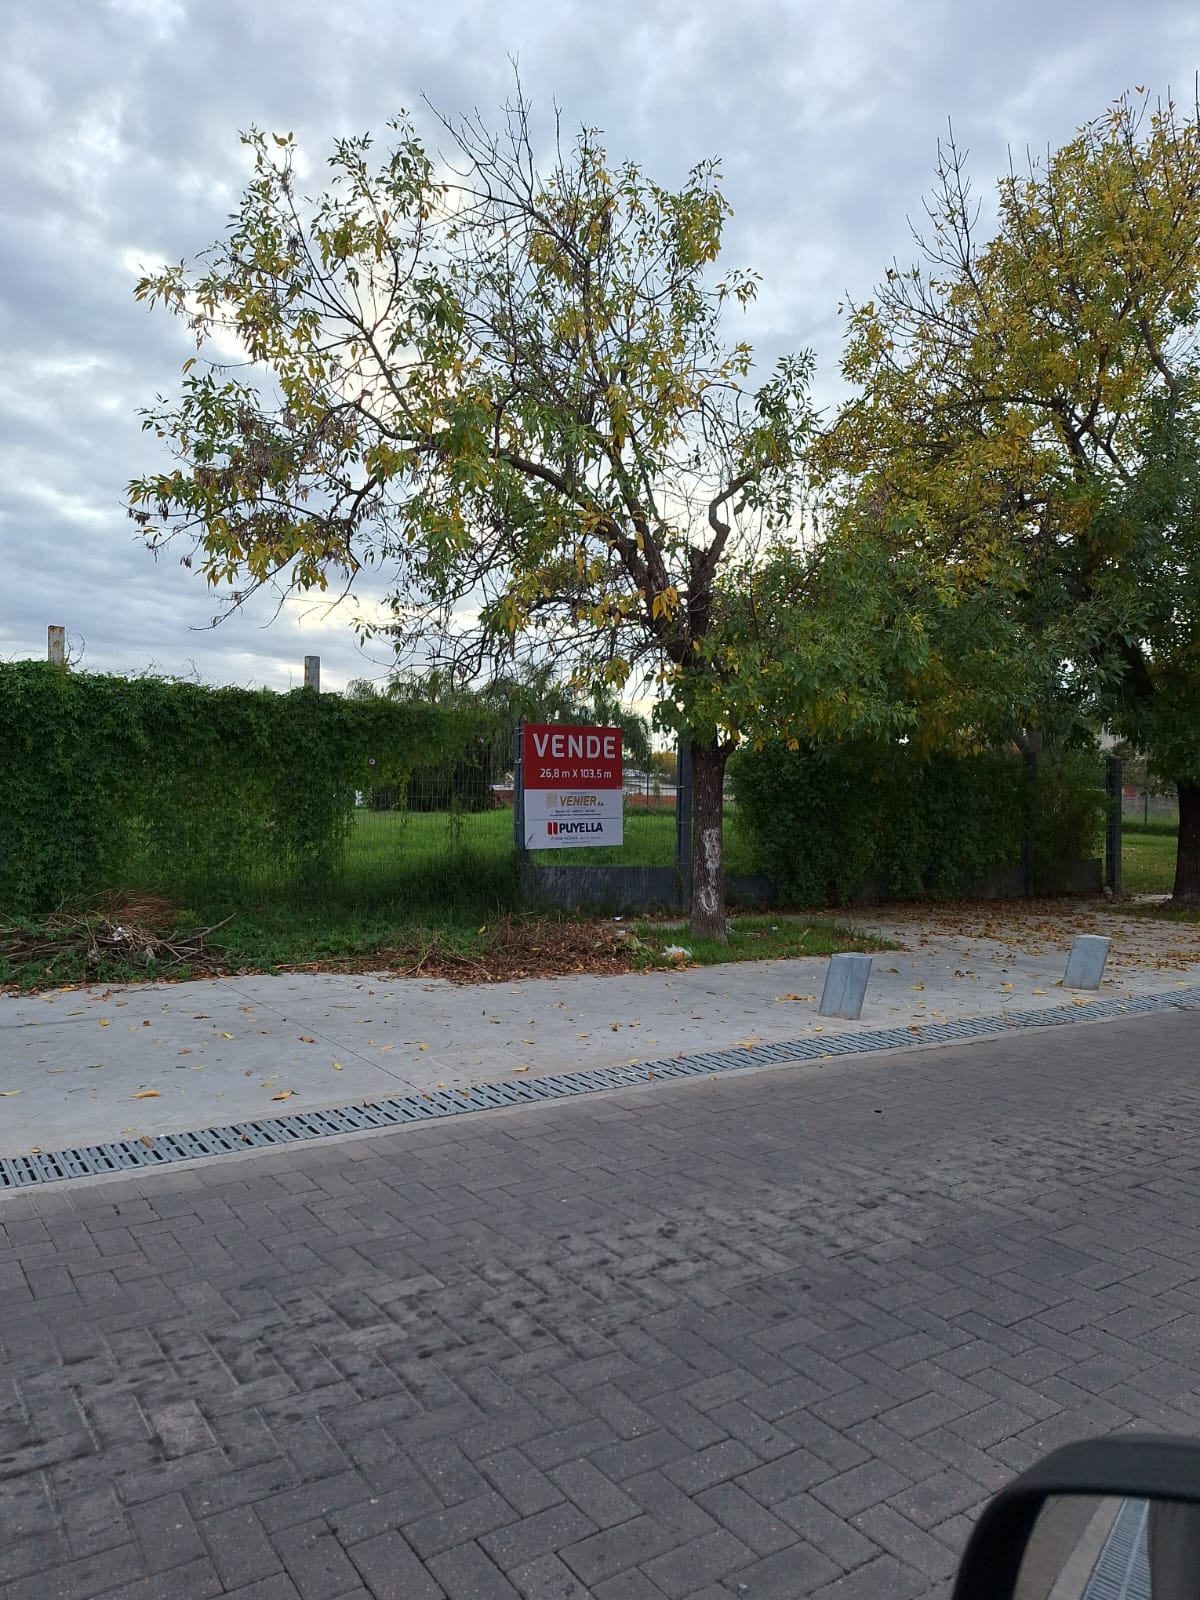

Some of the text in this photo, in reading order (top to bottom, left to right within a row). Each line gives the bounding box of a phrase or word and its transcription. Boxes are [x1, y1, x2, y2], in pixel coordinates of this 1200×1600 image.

[533, 733, 616, 759] VENDE
[540, 768, 560, 779] 26,8
[561, 770, 570, 778] m
[580, 768, 602, 779] 103,5
[560, 795, 597, 807] VENIER
[559, 822, 603, 833] PUYELLA
